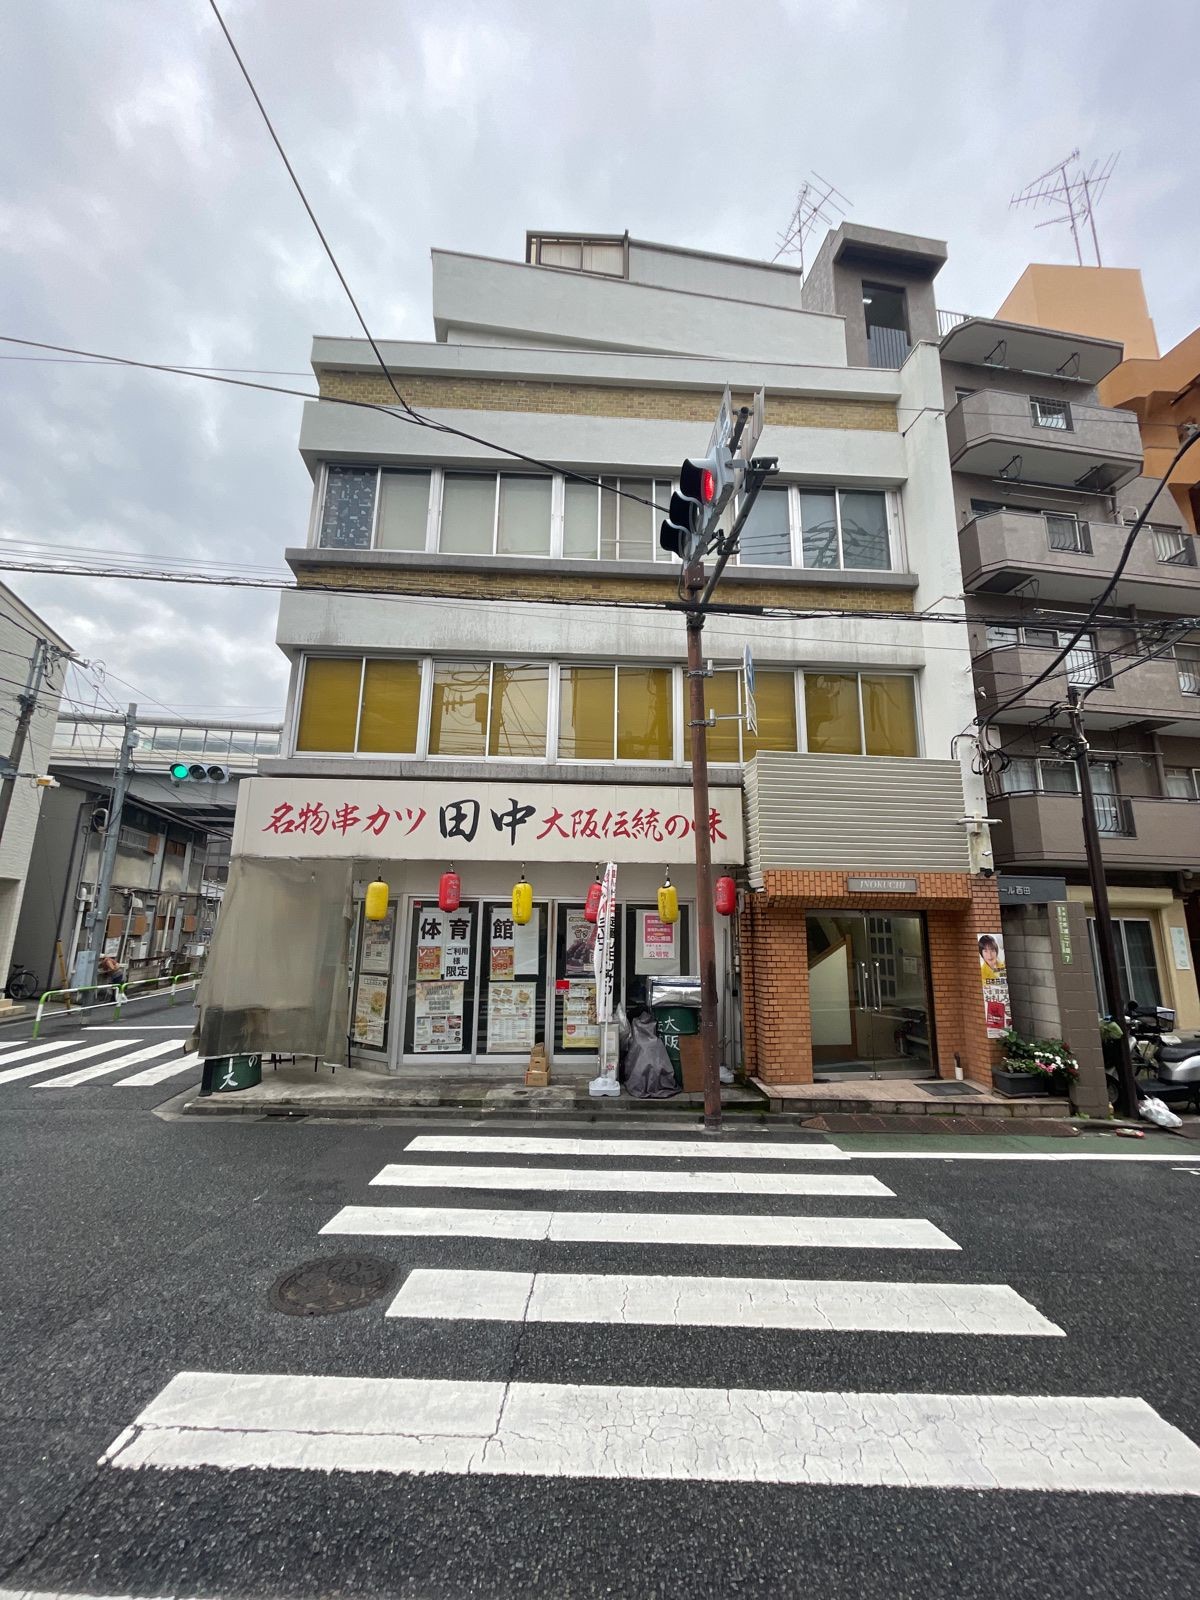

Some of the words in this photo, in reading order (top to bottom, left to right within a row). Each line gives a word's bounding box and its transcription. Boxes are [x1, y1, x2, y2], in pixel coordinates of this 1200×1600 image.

[262, 802, 427, 836] 名物串カツ
[439, 798, 537, 846] 田中
[860, 880, 906, 889] INOKUCHI
[446, 947, 469, 957] ご利用
[453, 957, 460, 965] 様
[445, 965, 468, 977] 限定
[664, 1015, 681, 1051] 大阪
